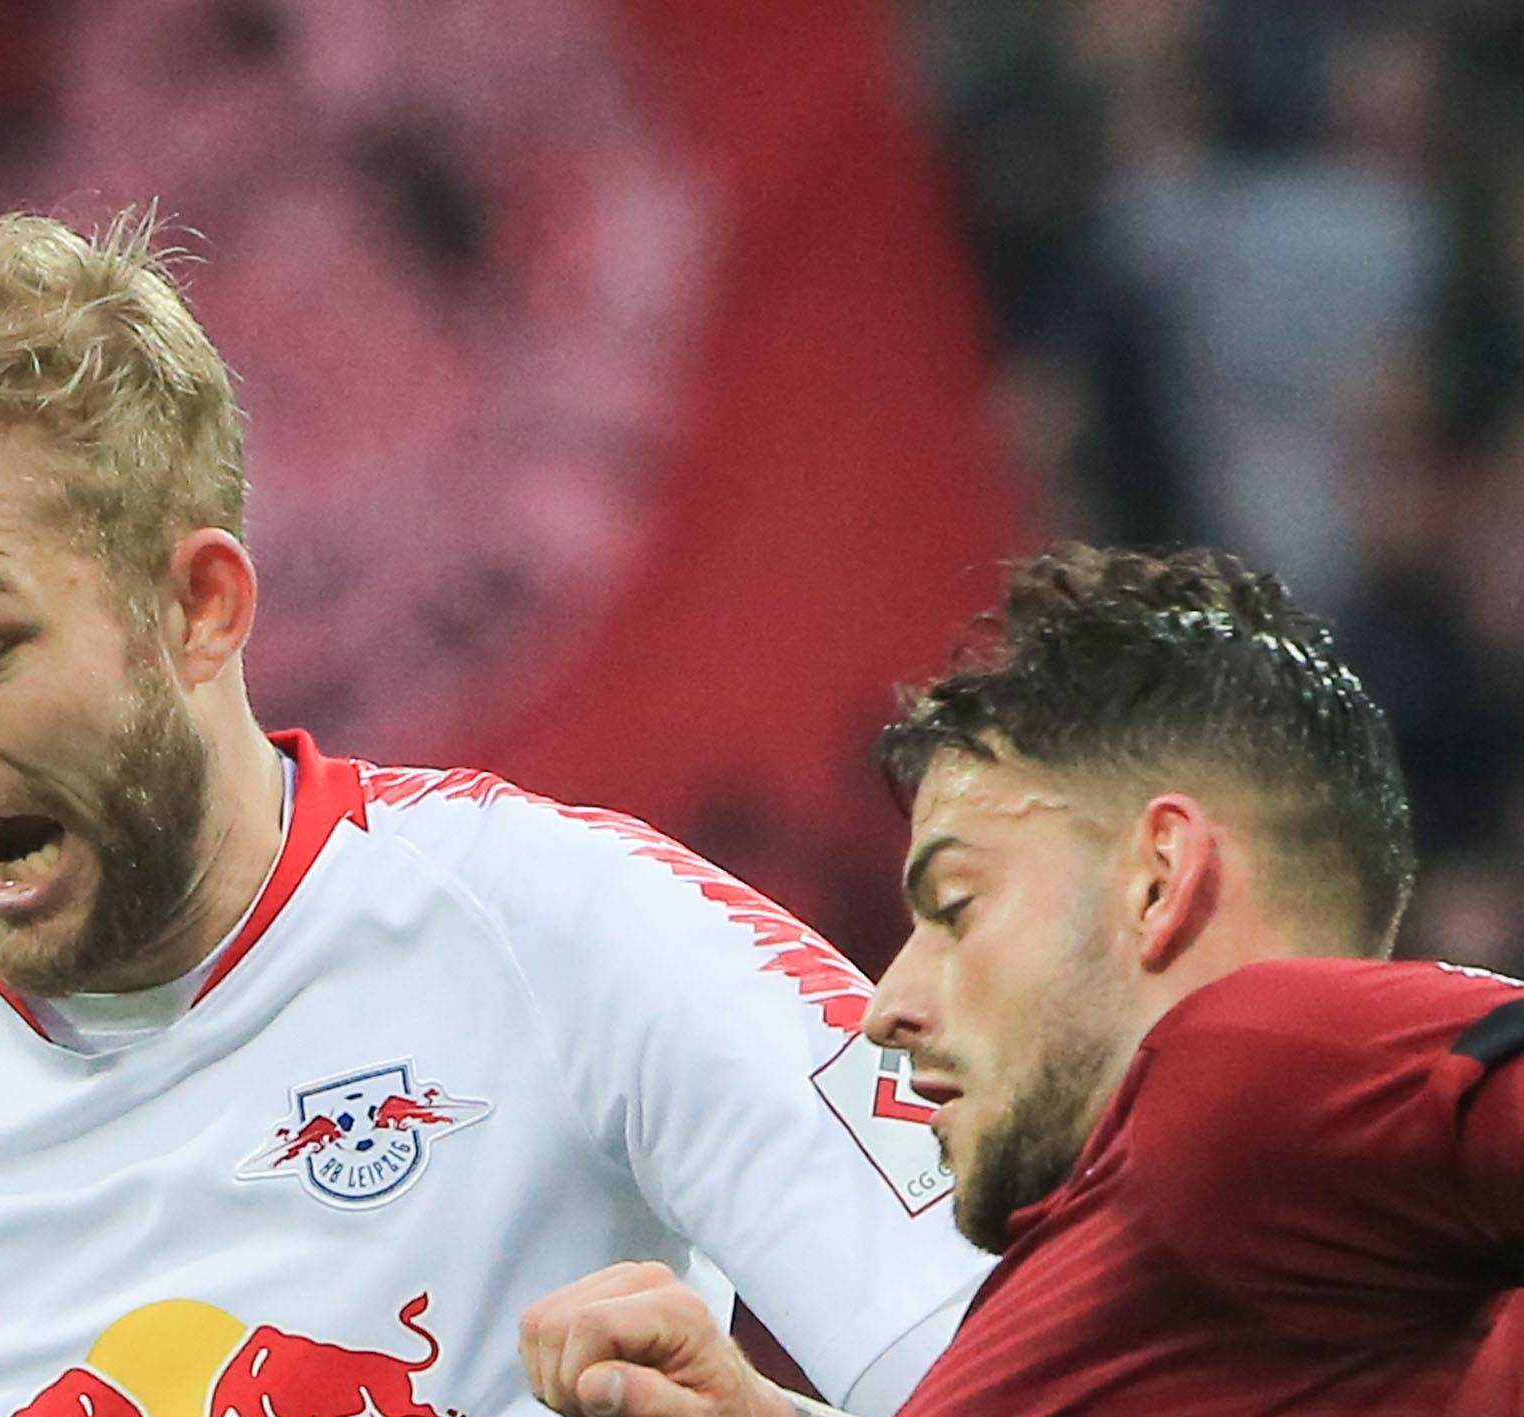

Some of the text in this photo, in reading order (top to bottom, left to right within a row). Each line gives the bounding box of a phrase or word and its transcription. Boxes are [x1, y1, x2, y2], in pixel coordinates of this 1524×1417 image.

[320, 1140, 412, 1189] RB LEIPZIG
[906, 1171, 936, 1198] CG
